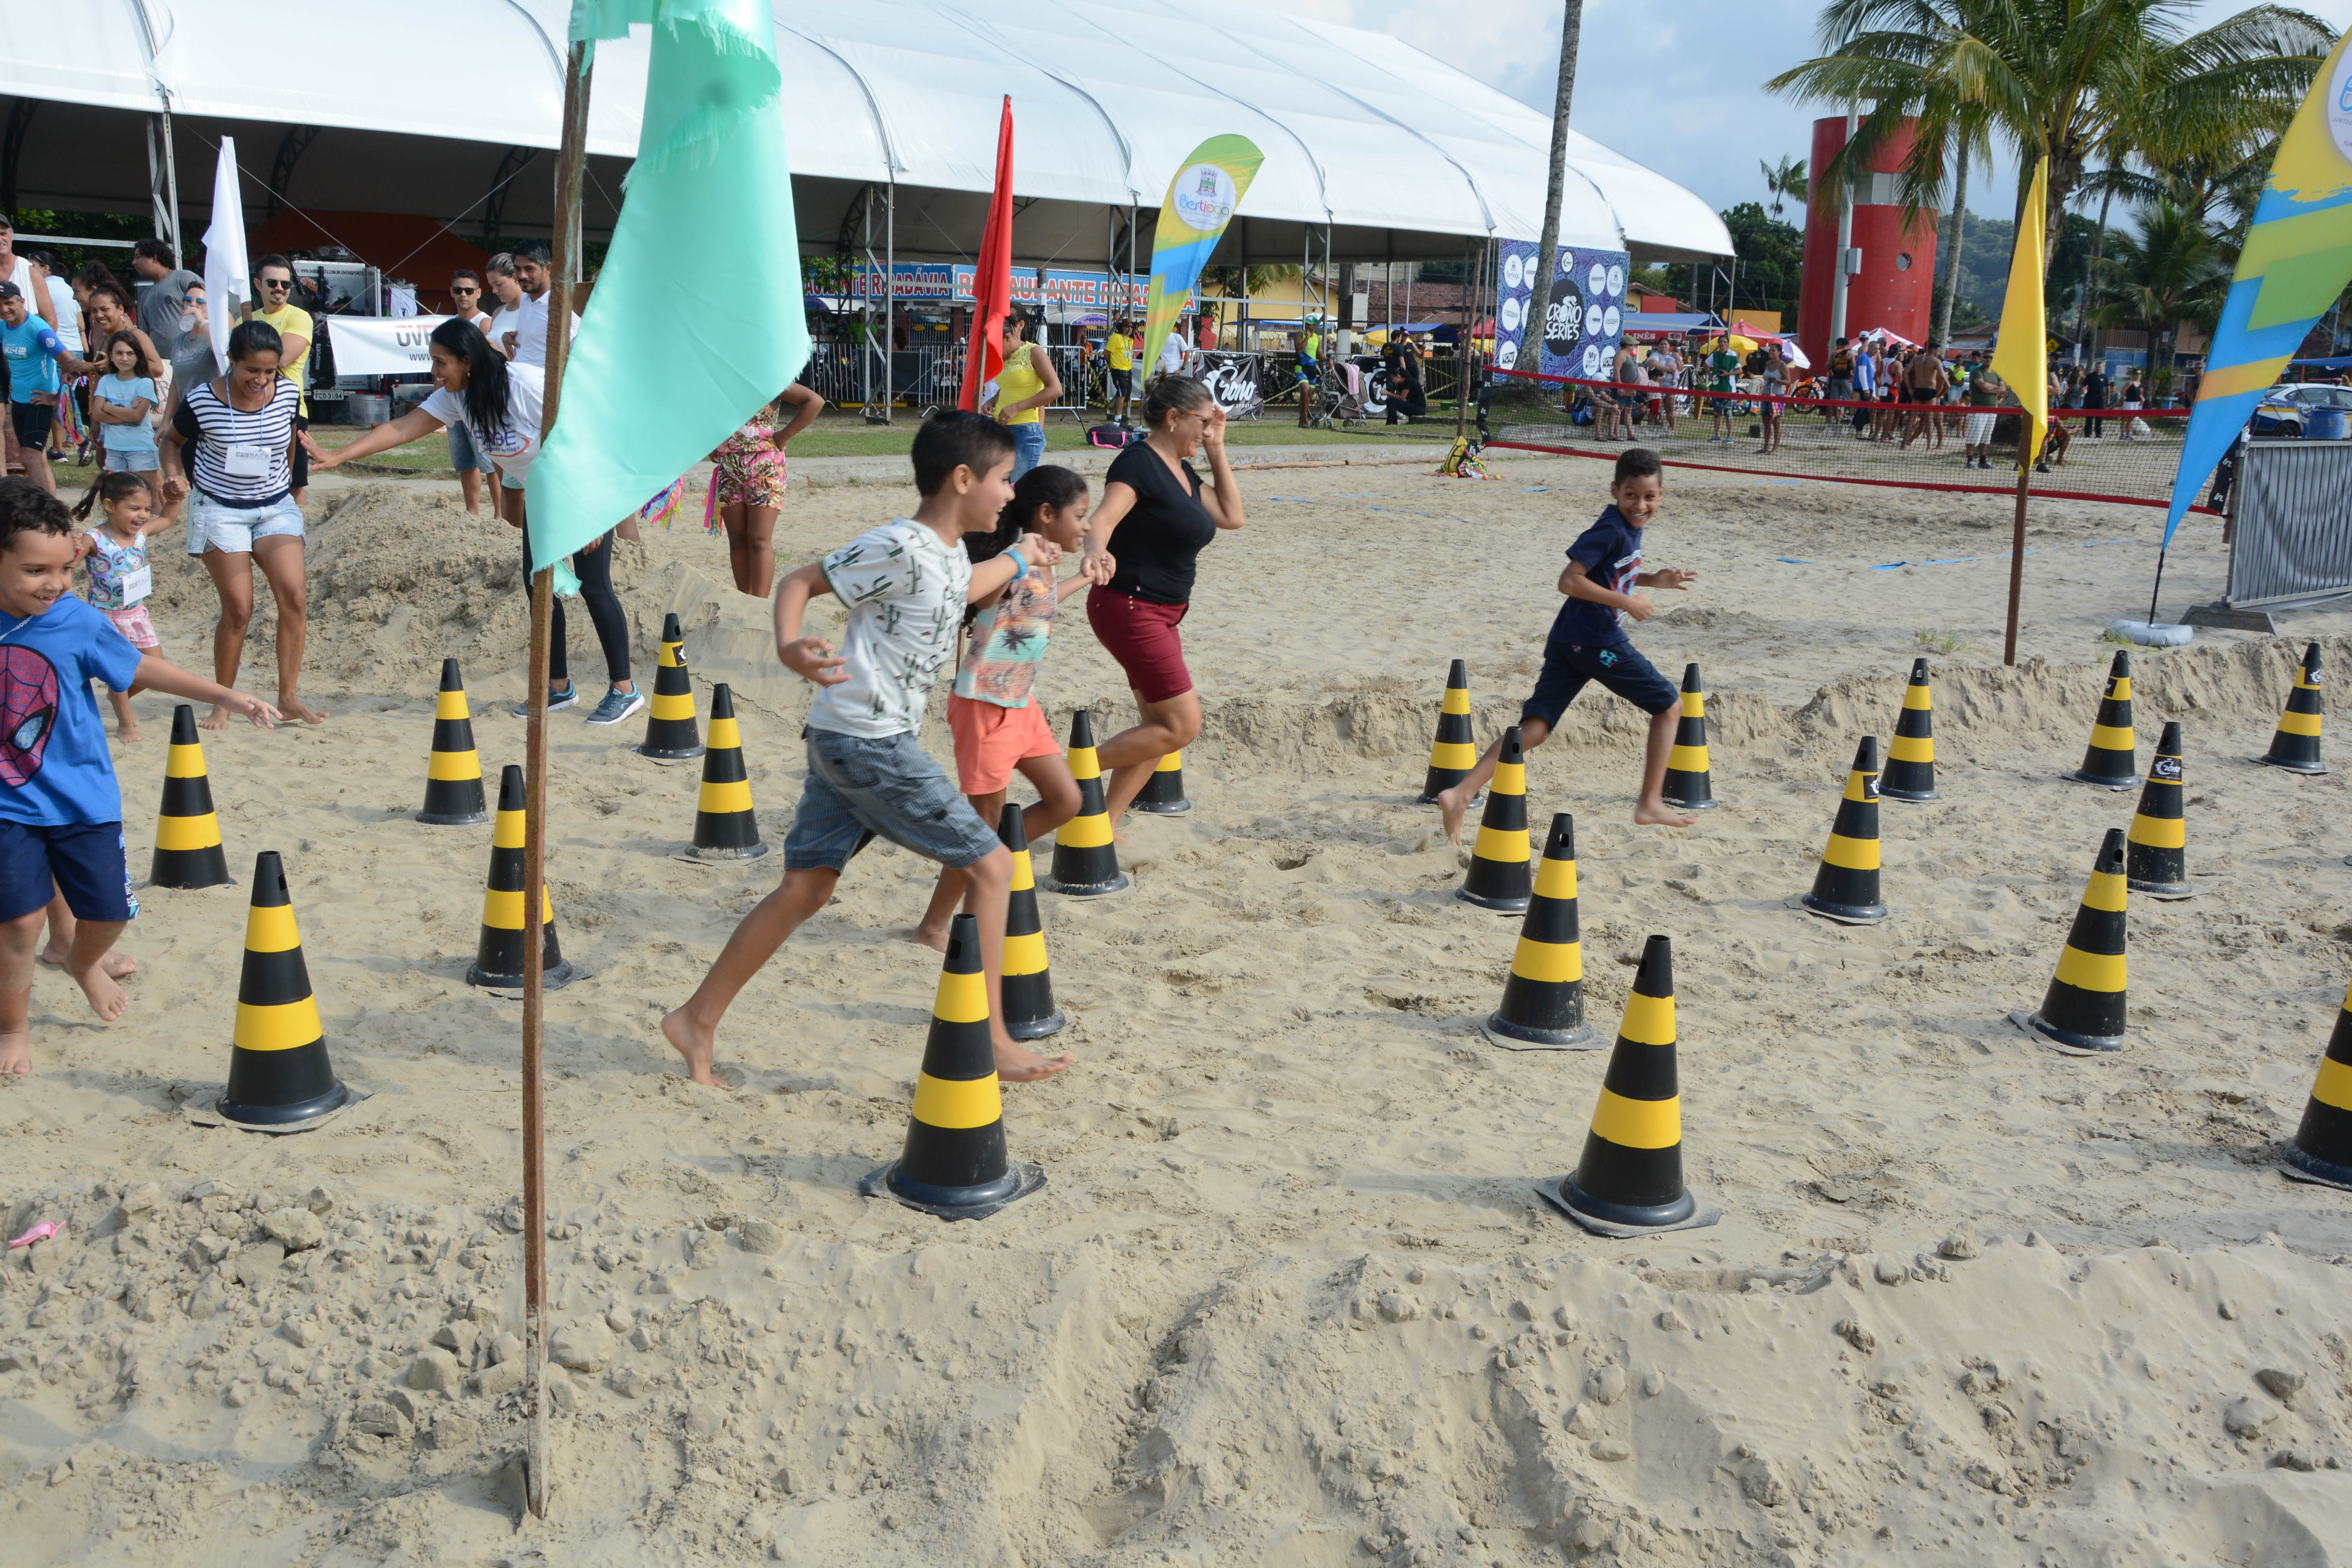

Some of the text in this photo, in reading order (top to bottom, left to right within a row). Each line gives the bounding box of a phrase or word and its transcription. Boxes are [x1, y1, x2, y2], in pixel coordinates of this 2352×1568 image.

[1180, 194, 1229, 218] Bertioga
[1633, 331, 1656, 340] INÊS
[1588, 352, 1596, 361] My
